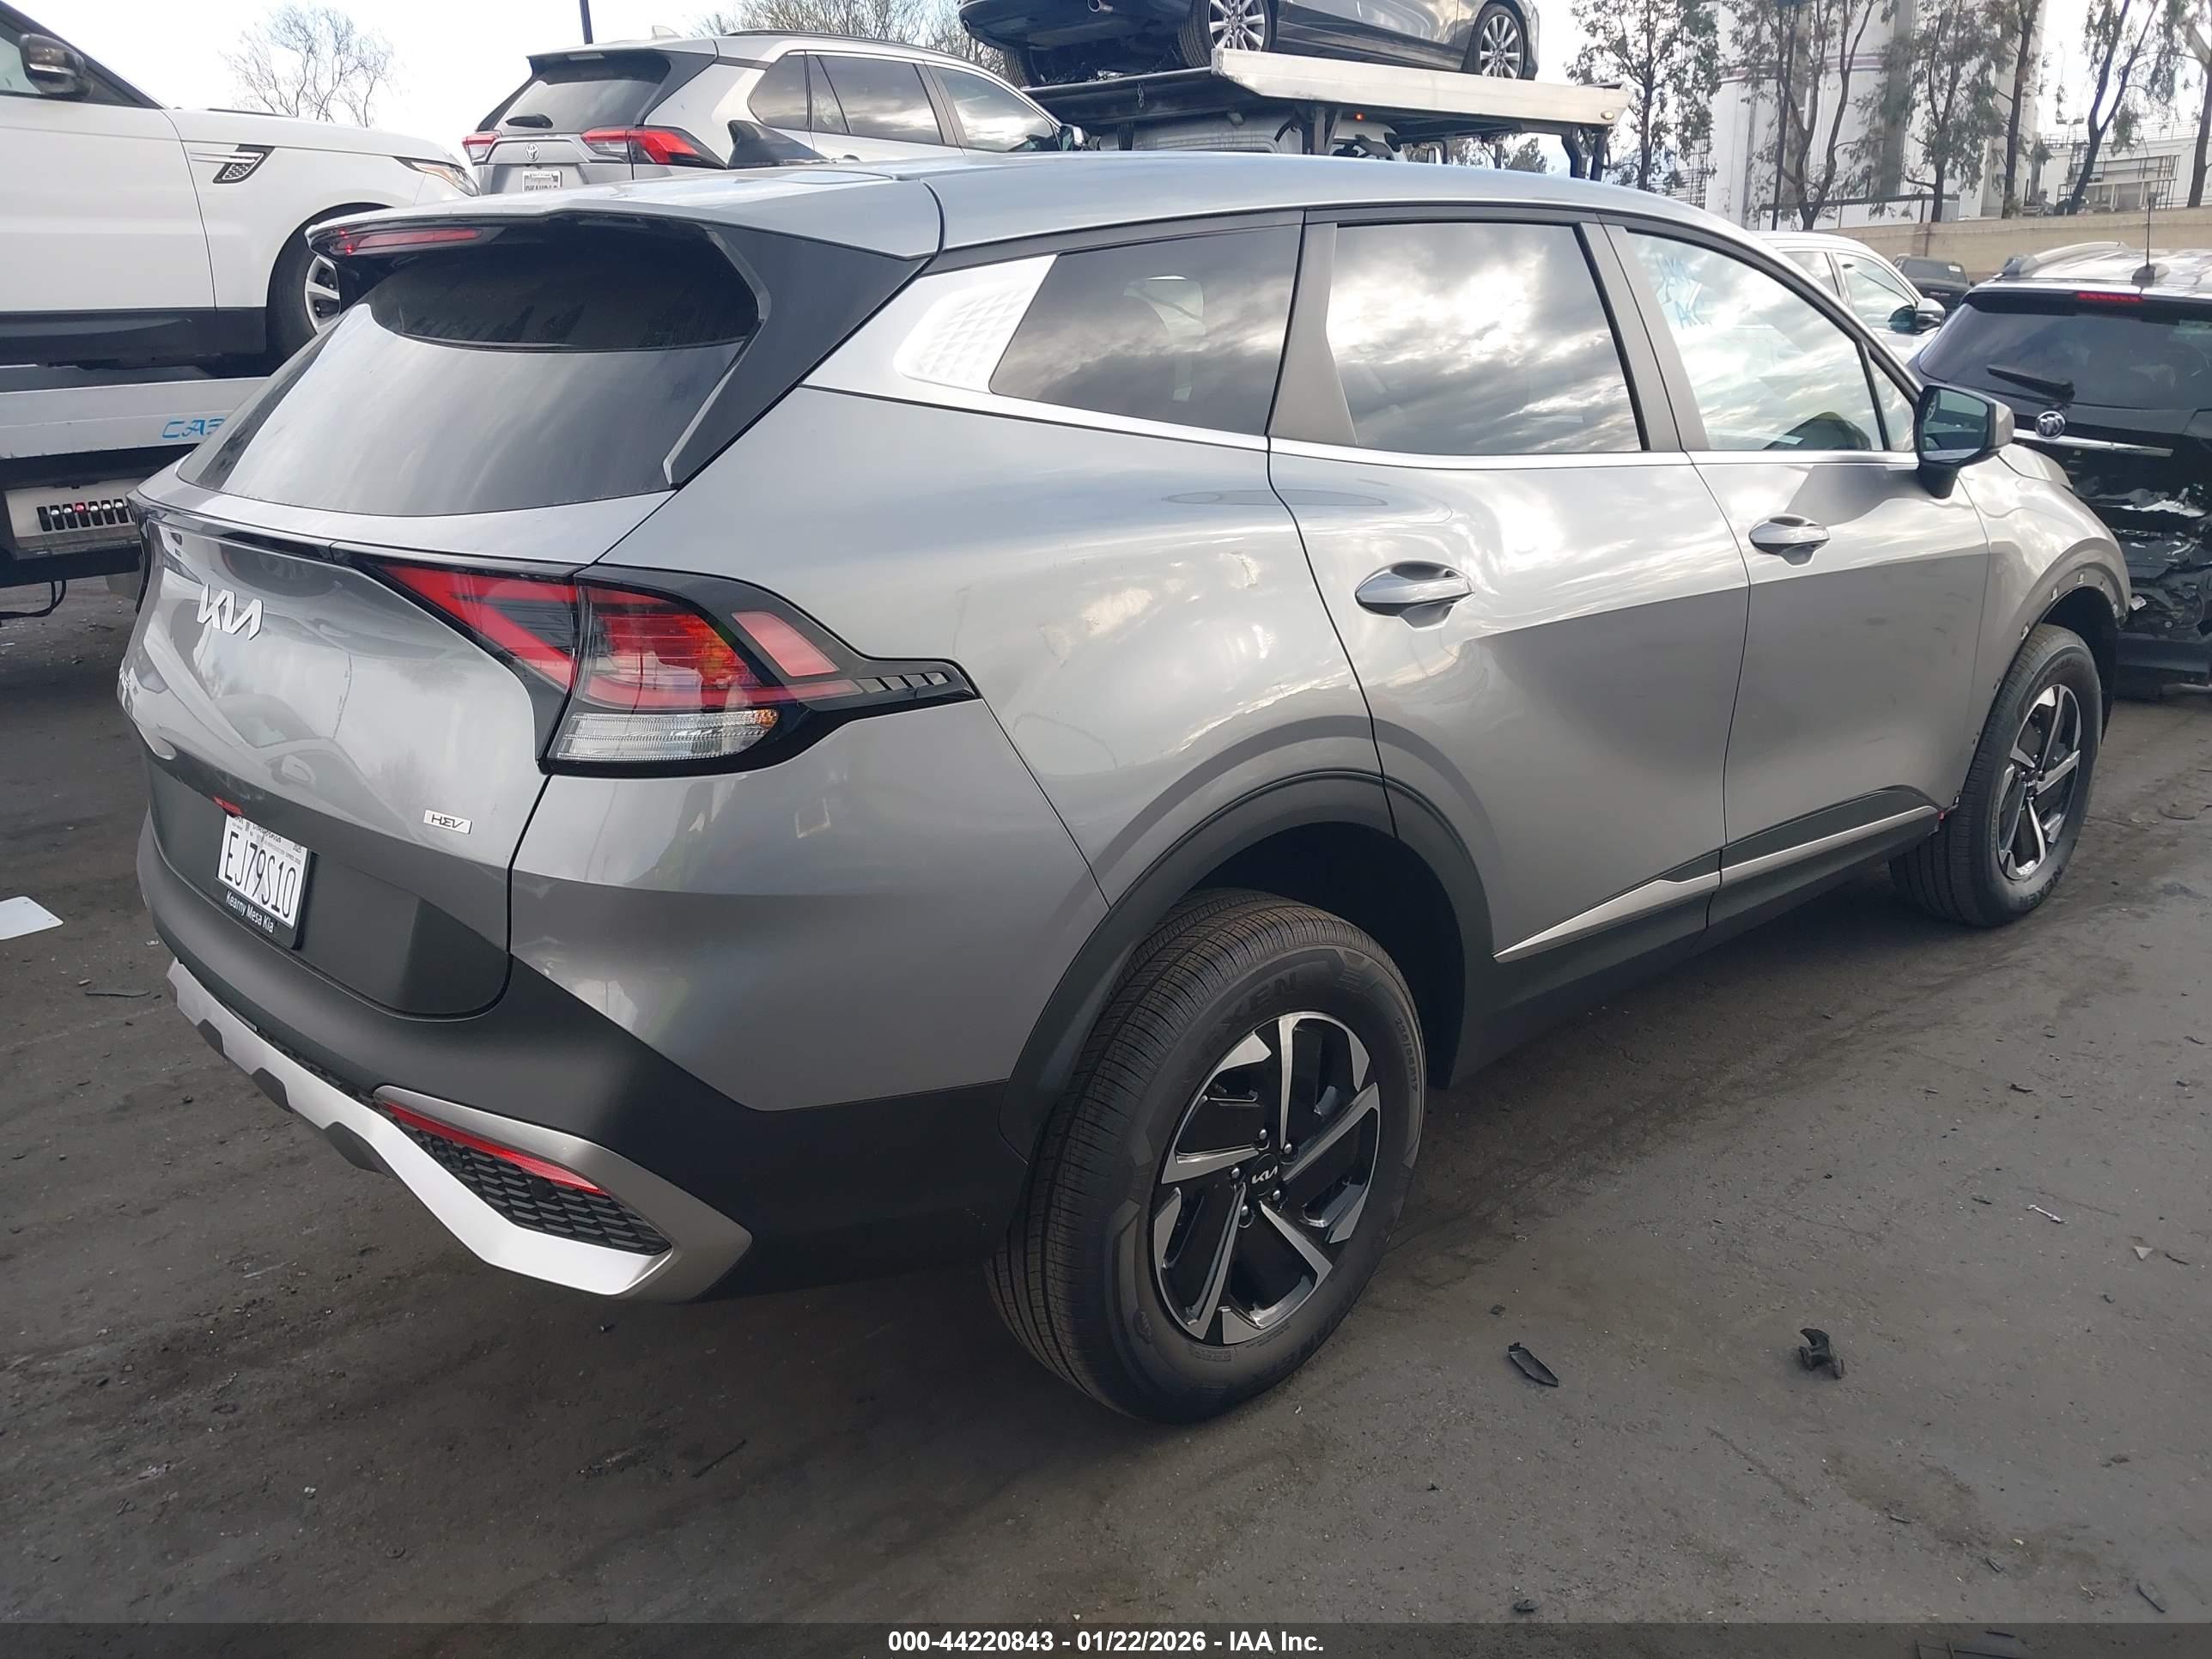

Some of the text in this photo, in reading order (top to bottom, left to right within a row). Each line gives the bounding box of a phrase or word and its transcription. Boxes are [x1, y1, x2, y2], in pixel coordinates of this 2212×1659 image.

[197, 584, 264, 641] KIA
[432, 814, 464, 829] HEV
[224, 830, 297, 919] EJ79S10
[227, 890, 274, 933] Kearny Mesa Kia
[1251, 1165, 1279, 1184] KIA
